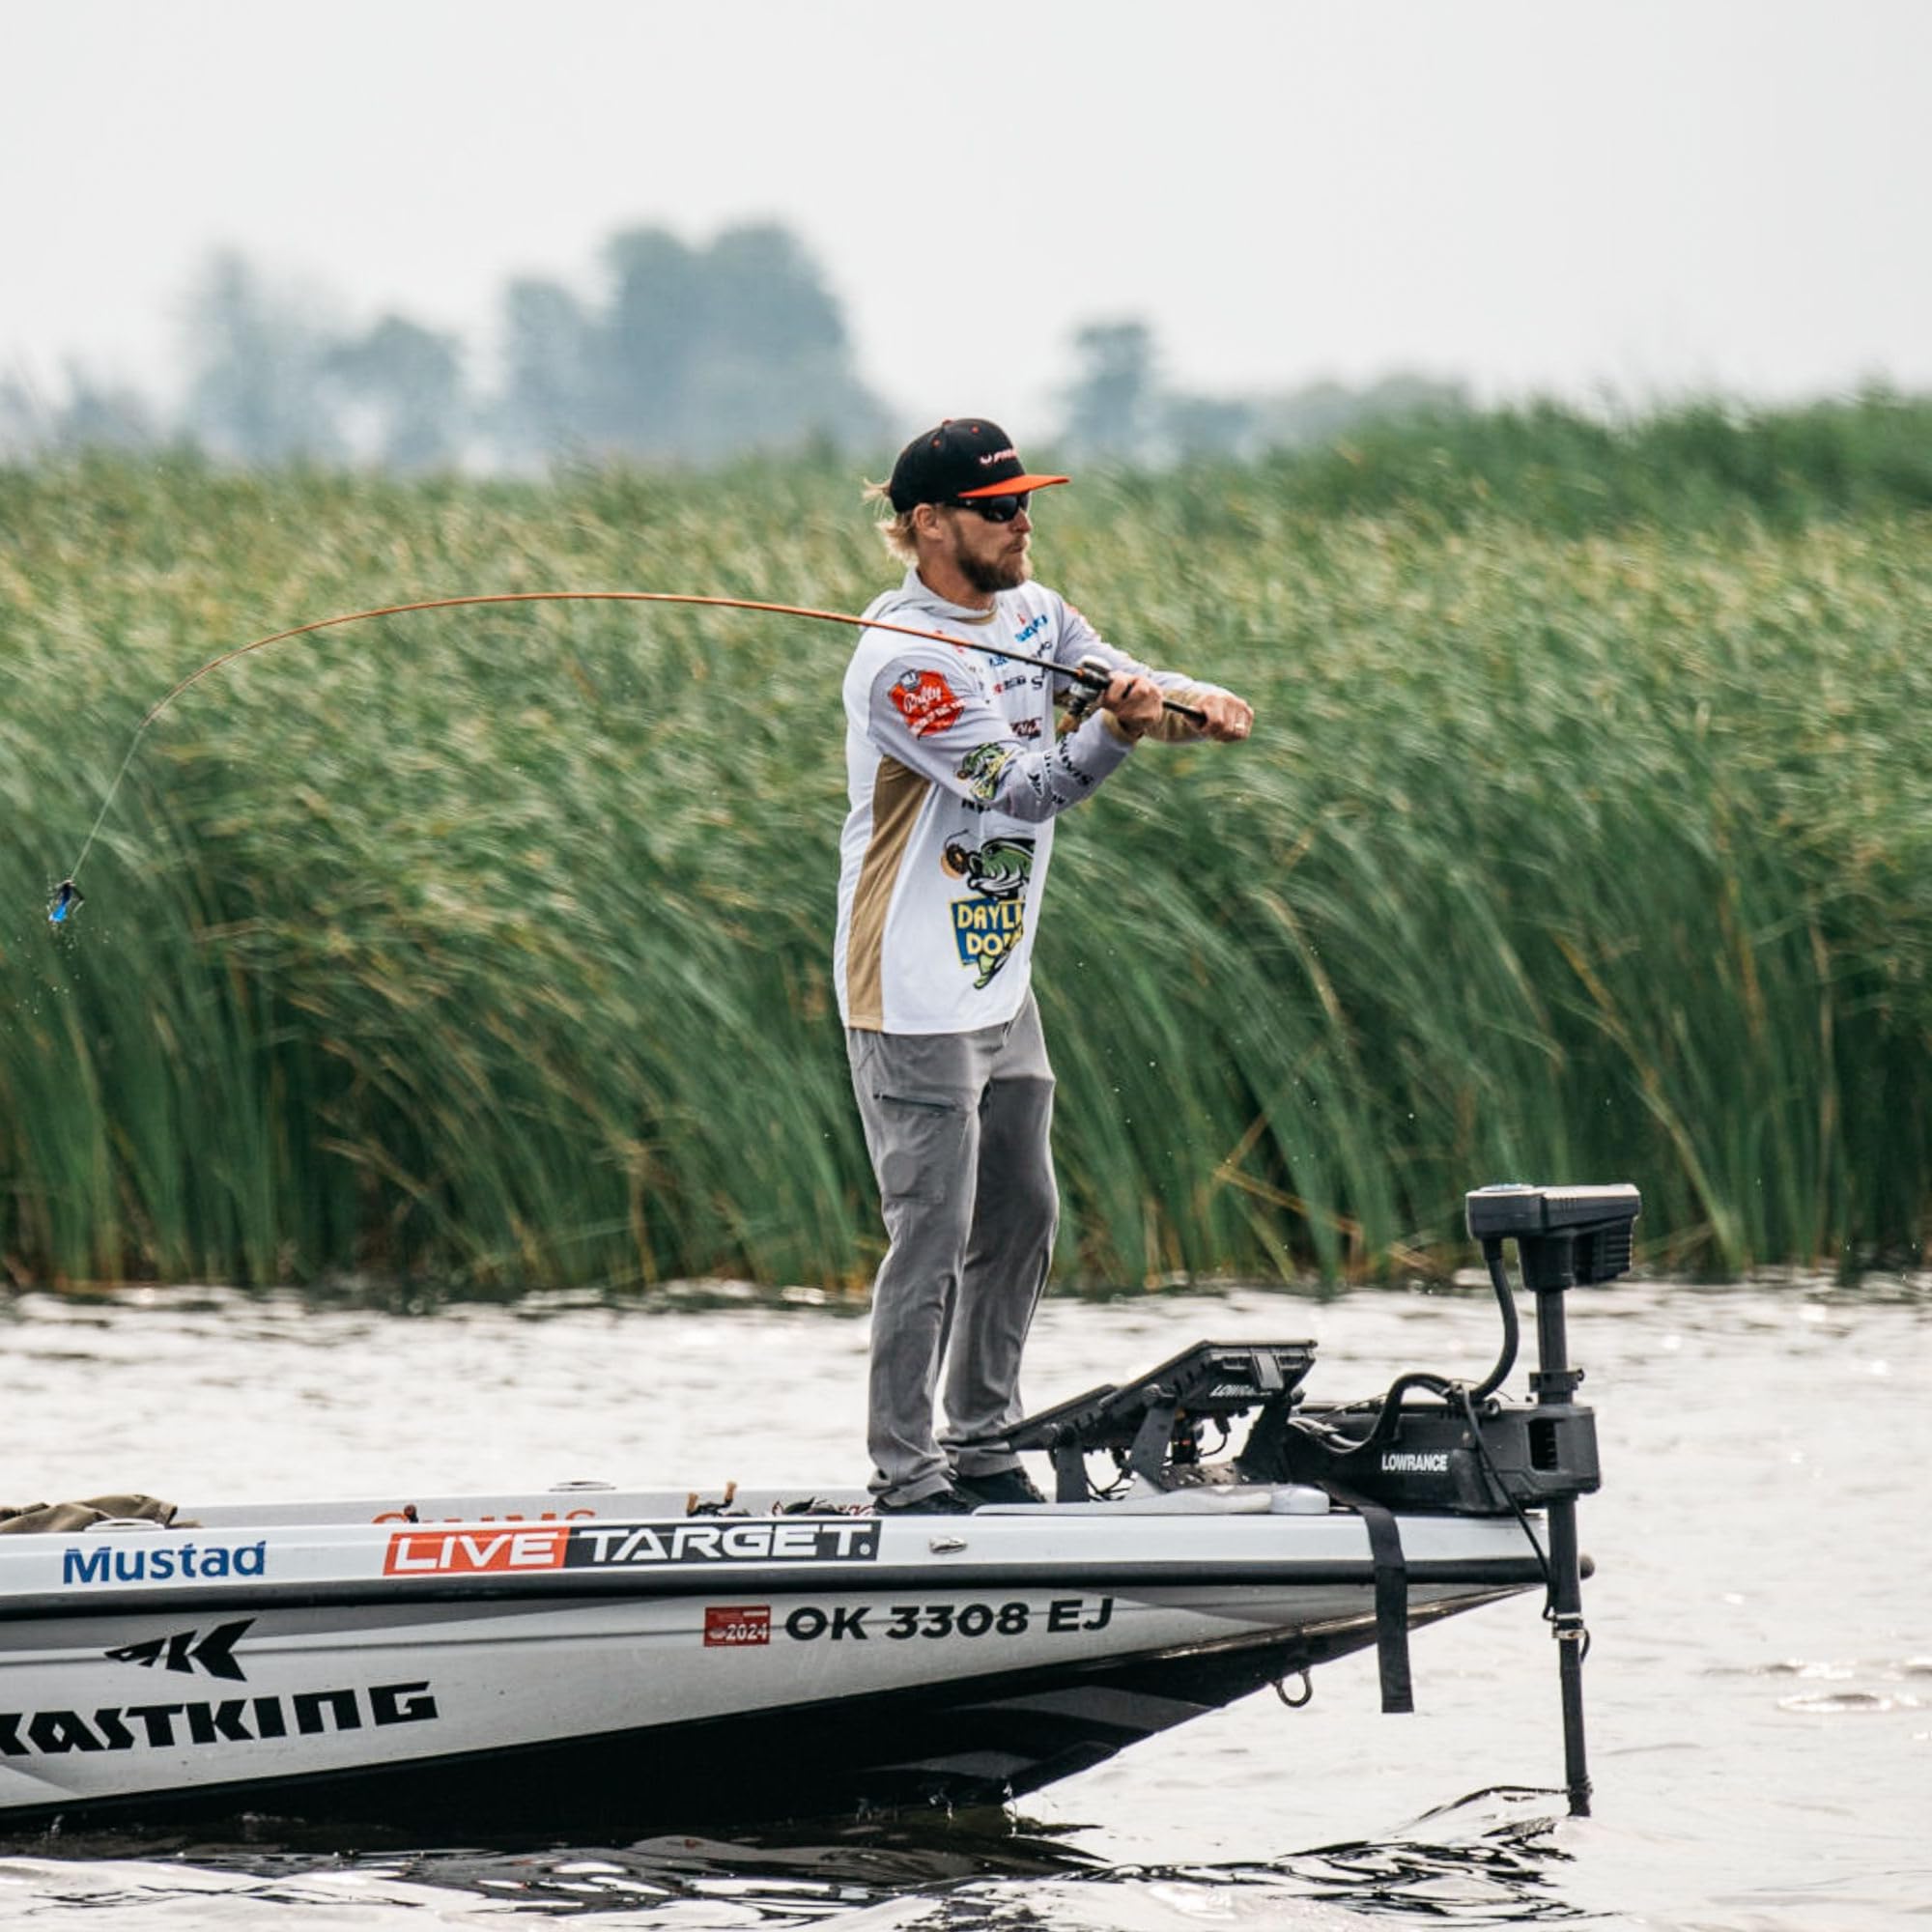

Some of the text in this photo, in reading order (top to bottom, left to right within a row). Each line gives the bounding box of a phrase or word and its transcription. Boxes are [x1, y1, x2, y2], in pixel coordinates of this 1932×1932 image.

[1381, 1453, 1448, 1472] LOWRANCE
[63, 1540, 267, 1585] Mustad
[394, 1531, 559, 1571] LIVE
[725, 1623, 768, 1641] 2024
[784, 1597, 1115, 1641] OK 3308 EJ
